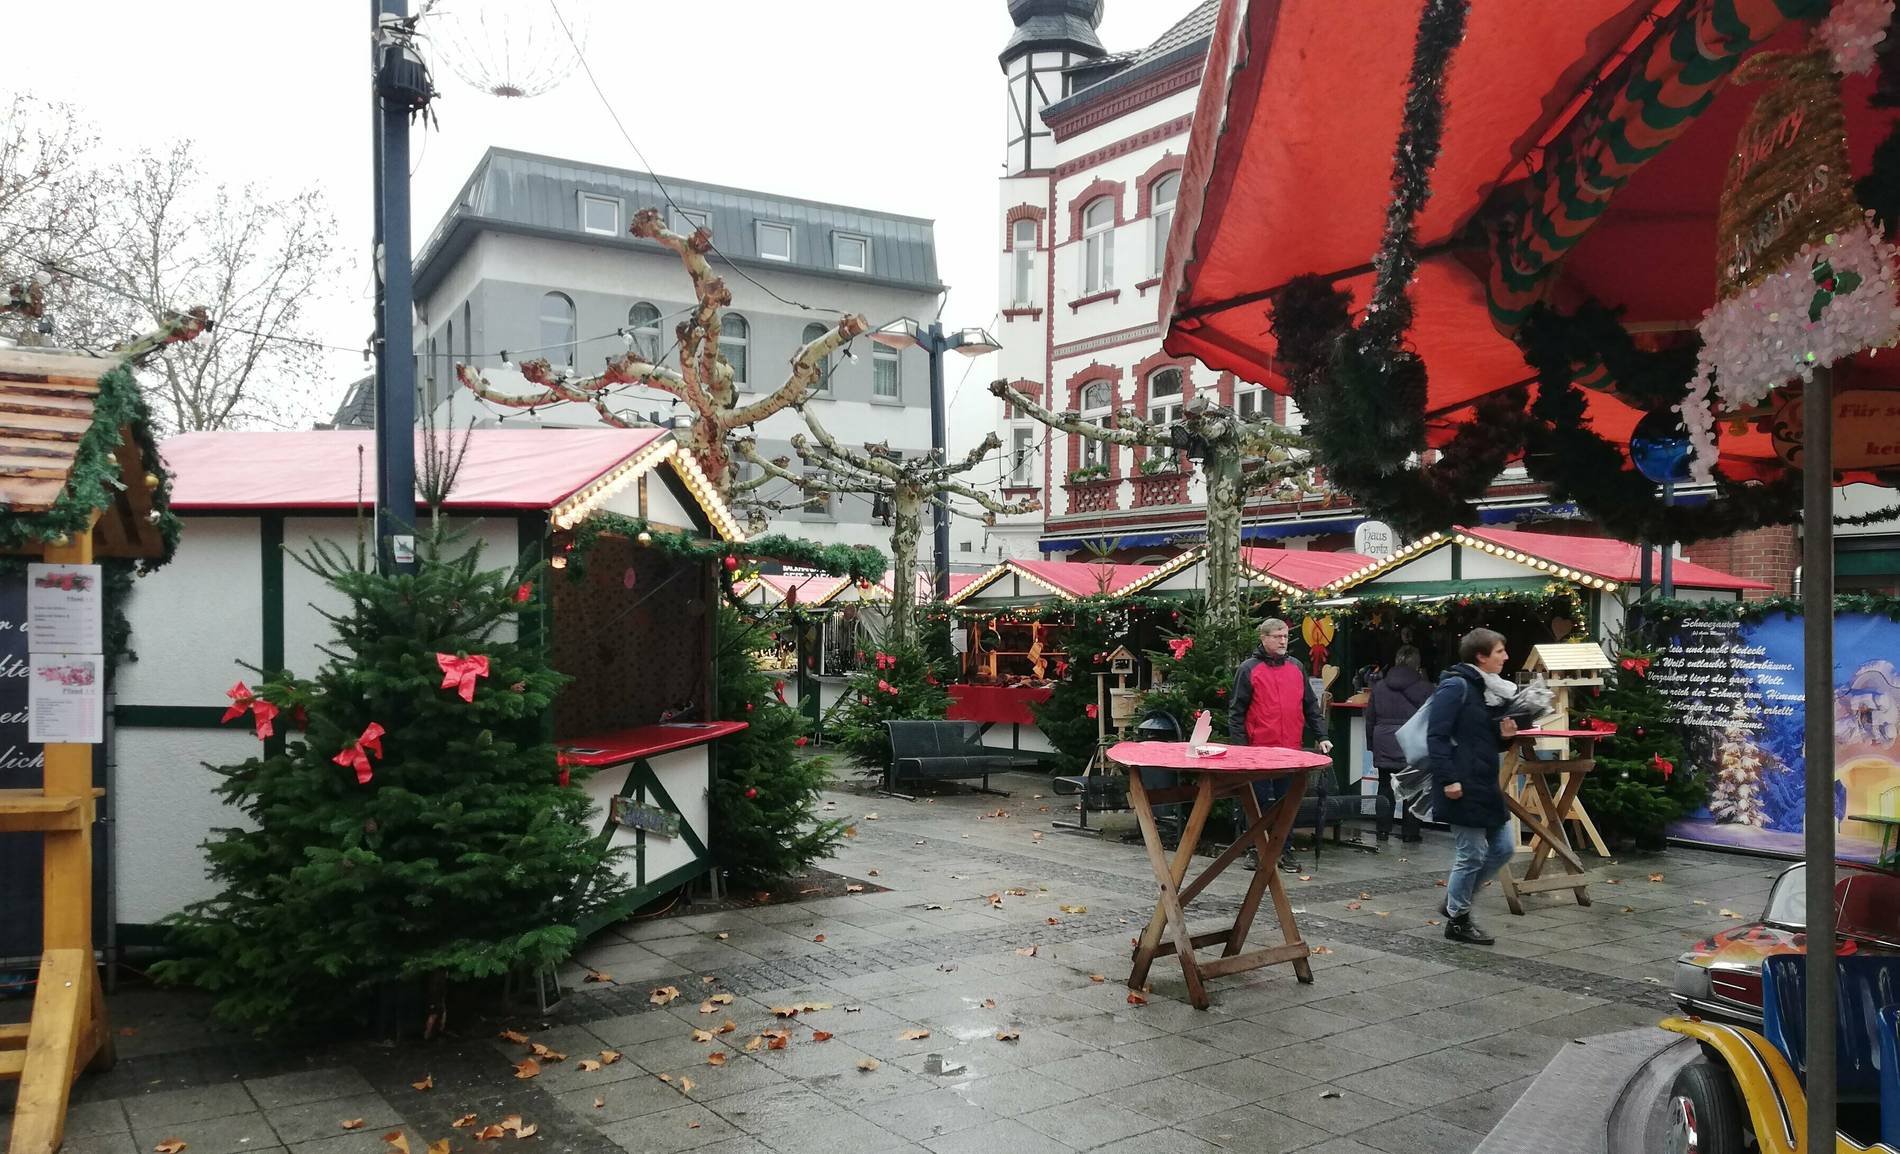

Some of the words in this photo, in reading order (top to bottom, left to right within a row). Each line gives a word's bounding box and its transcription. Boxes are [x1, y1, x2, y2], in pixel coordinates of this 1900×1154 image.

[1685, 644, 1705, 653] und
[1705, 645, 1729, 654] sacht
[1730, 644, 1767, 655] bedeckt
[1662, 657, 1685, 668] Weiß
[1687, 658, 1728, 669] entlaubte
[1729, 658, 1795, 671] Winterbäume.
[1689, 672, 1711, 685] liegt
[1711, 673, 1727, 683] die
[1729, 676, 1754, 686] ganze
[1757, 673, 1785, 685] Welt.
[1669, 686, 1690, 696] reich
[1691, 687, 1707, 697] der
[1708, 687, 1742, 698] Schnee
[1743, 690, 1763, 699] vom
[1715, 703, 1730, 713] die
[1733, 703, 1762, 714] Stadt
[1763, 704, 1794, 716] erhellt
